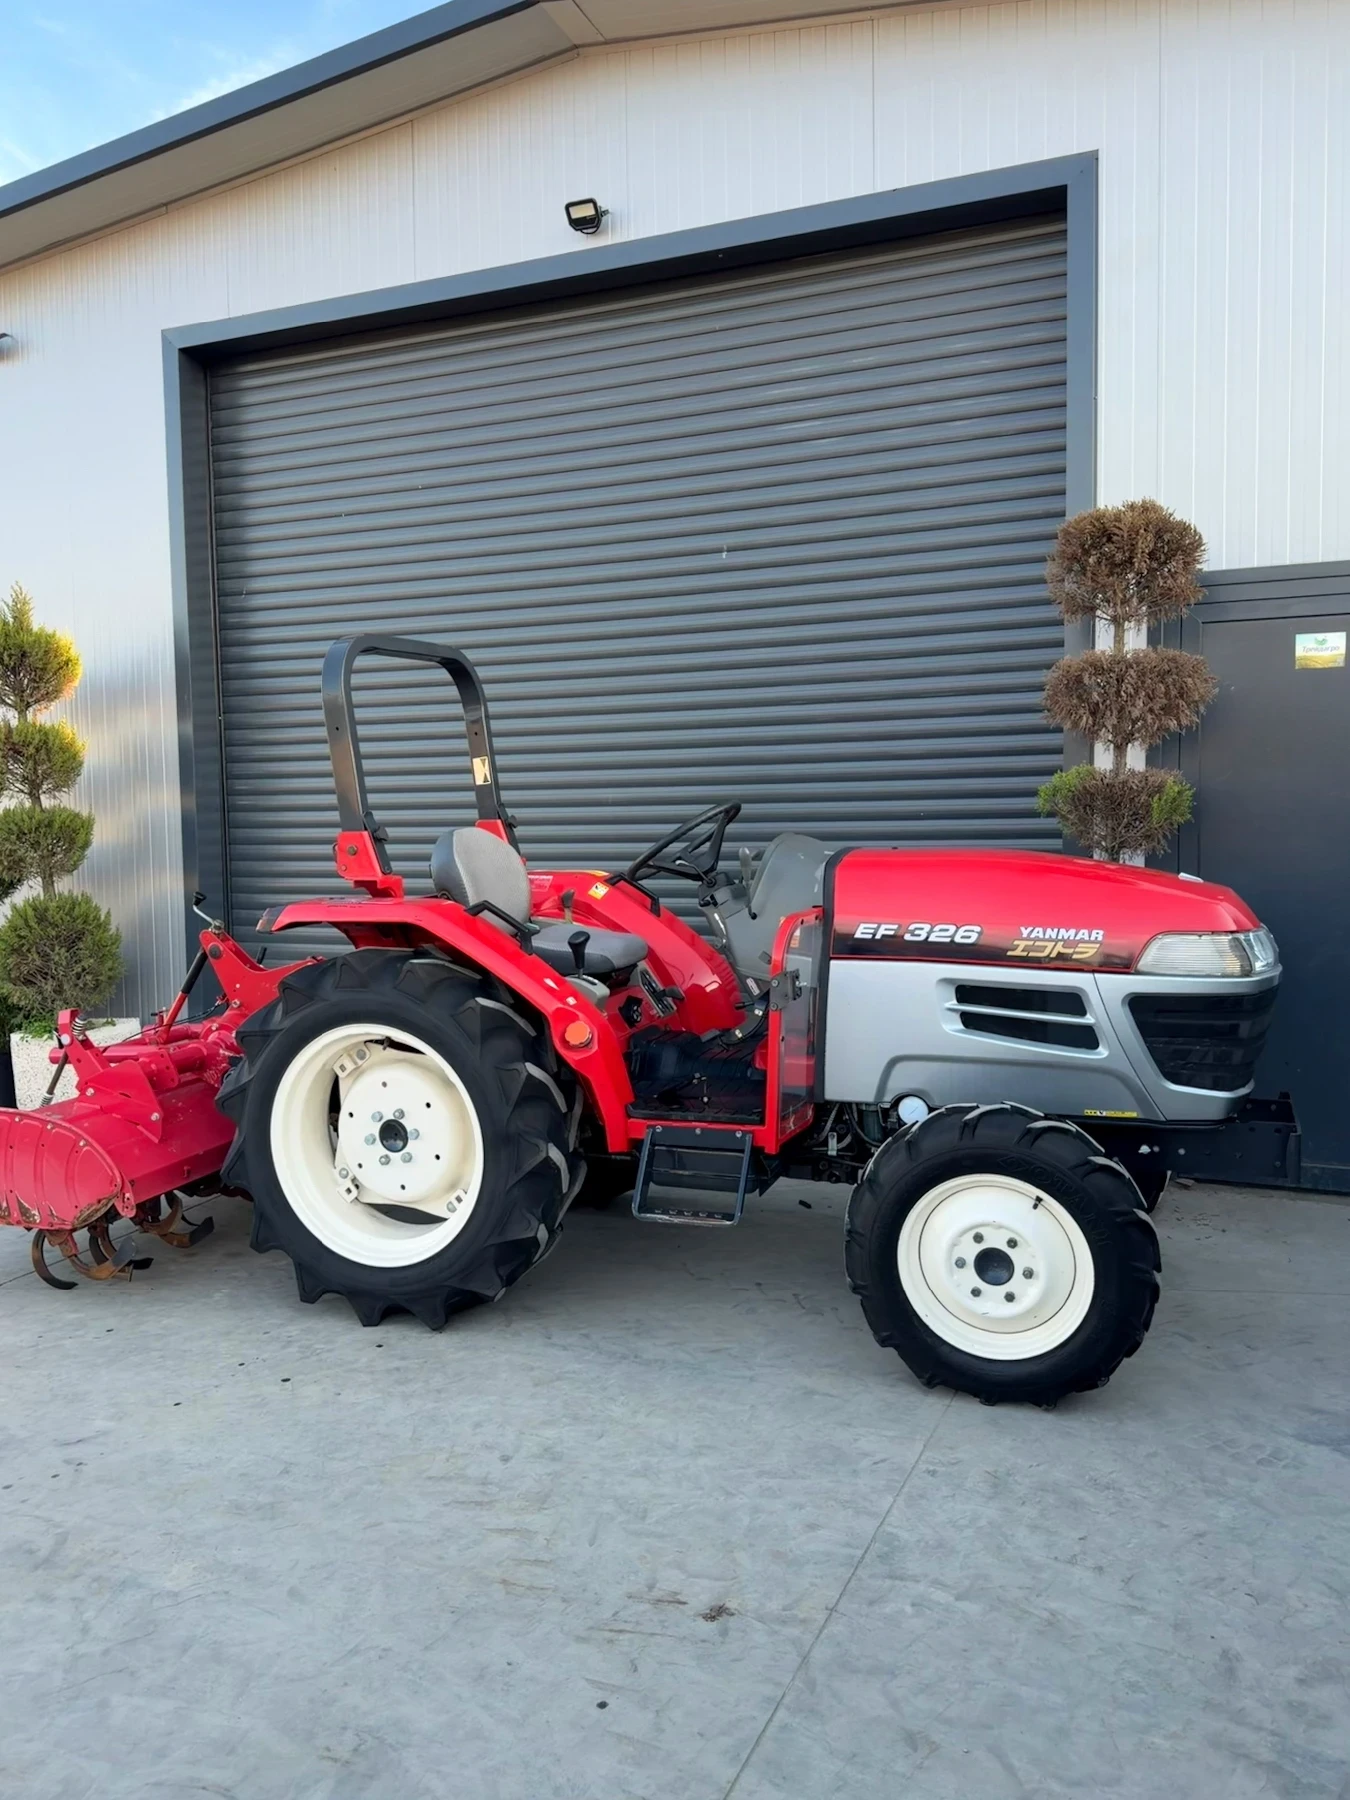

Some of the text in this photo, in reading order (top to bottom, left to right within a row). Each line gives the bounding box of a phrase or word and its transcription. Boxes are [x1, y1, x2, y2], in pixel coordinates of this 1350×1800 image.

[853, 923, 982, 944] EF 326
[1020, 926, 1104, 941] YANMAR
[1006, 940, 1101, 959] エコトラ
